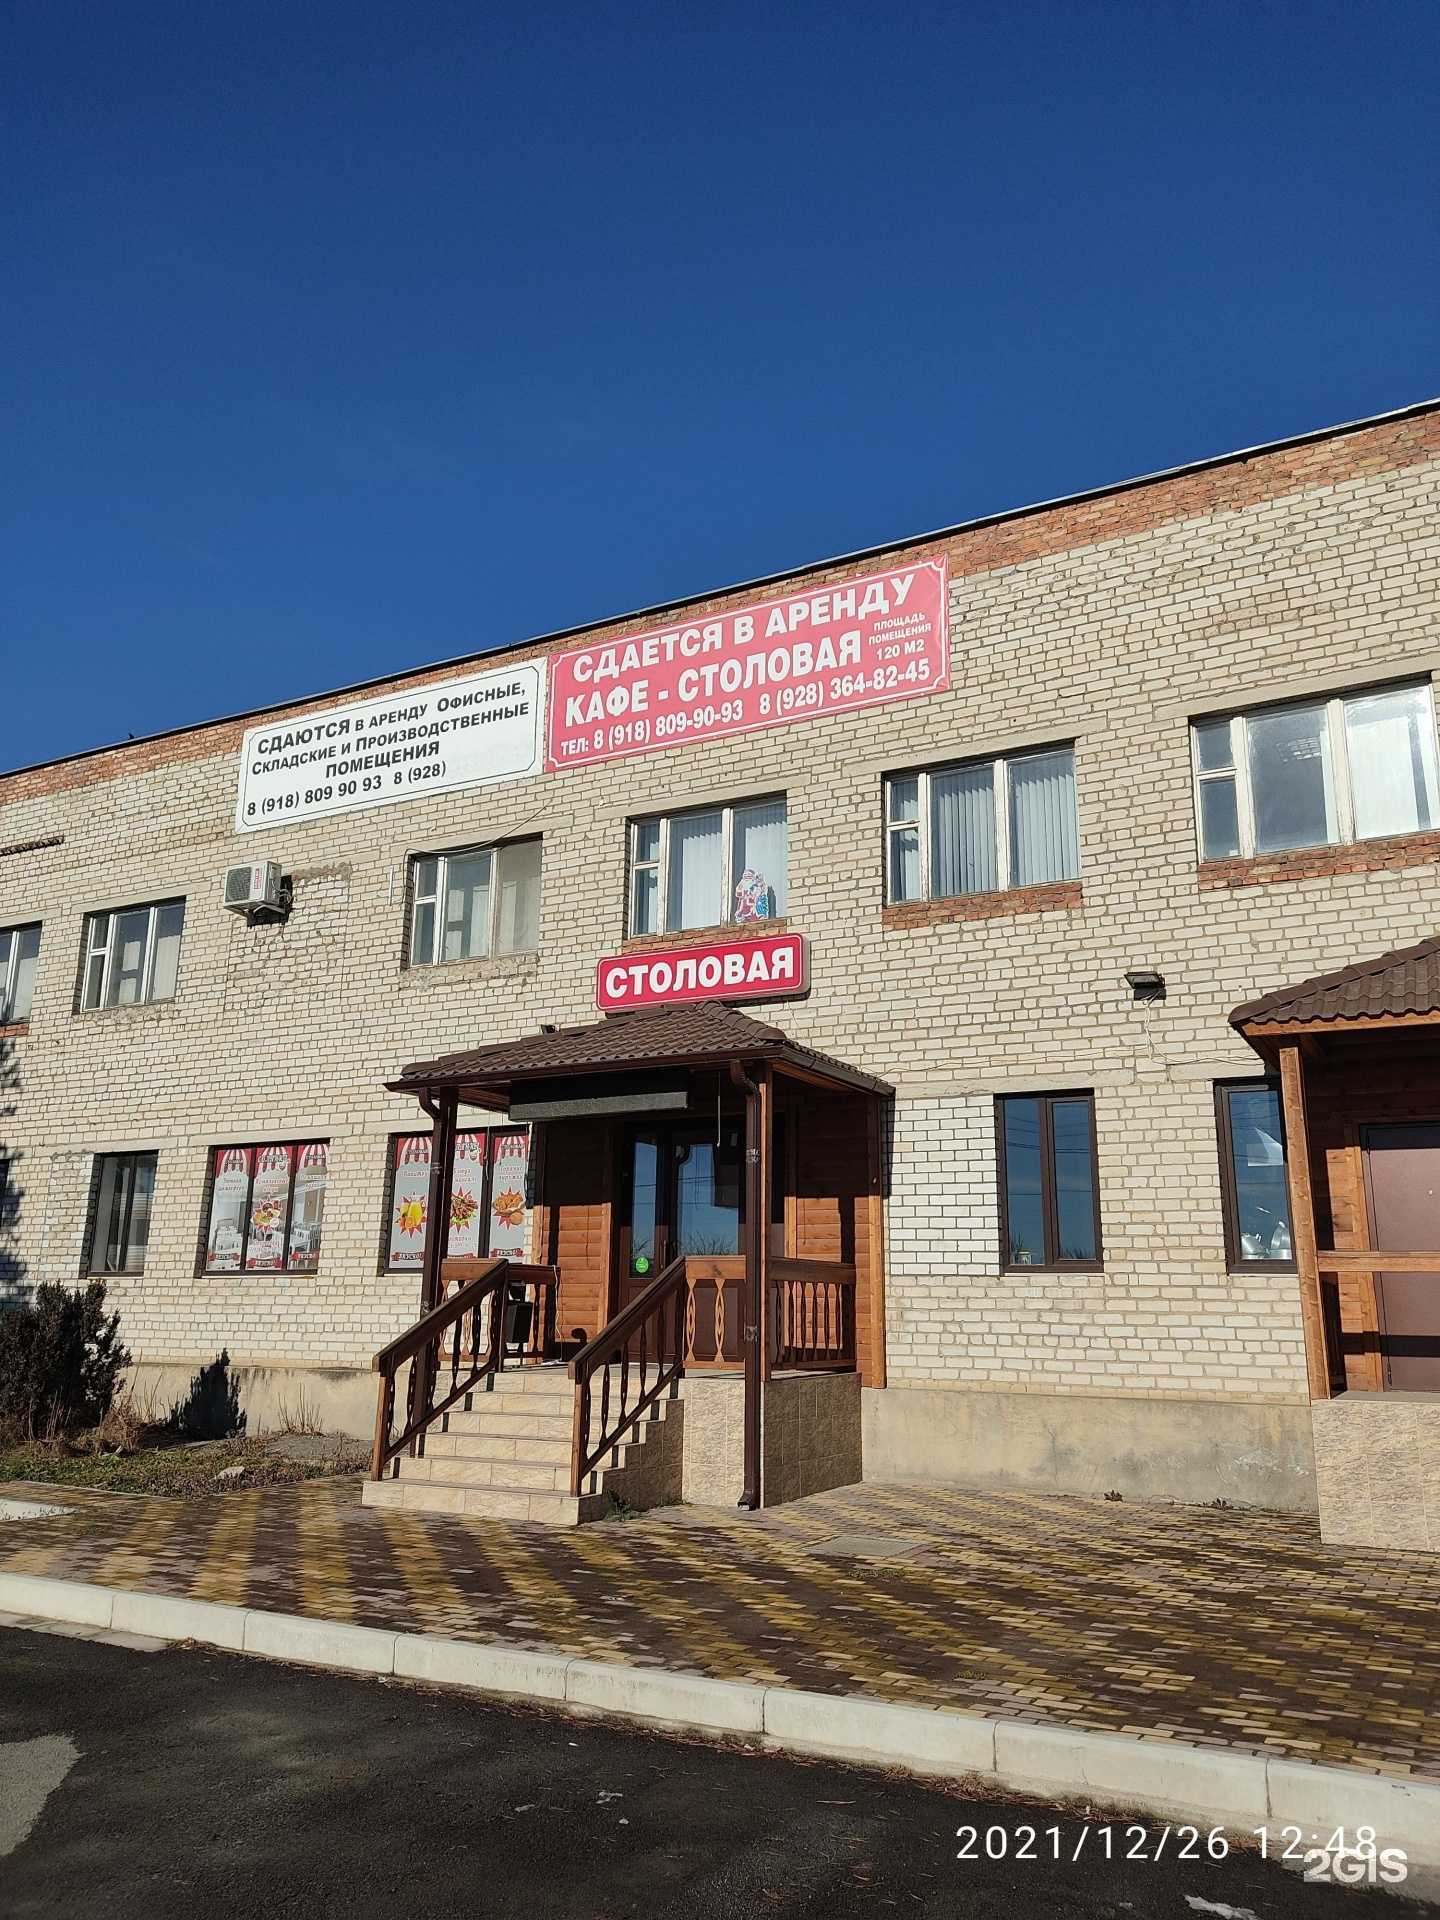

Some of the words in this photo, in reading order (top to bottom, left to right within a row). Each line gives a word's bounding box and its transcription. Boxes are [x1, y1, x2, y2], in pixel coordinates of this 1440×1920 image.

[573, 622, 723, 683] СДАЕТСЯ
[733, 614, 755, 645] В
[764, 574, 915, 638] АРЕНДУ
[868, 623, 932, 645] ПОМЕЩЕНИЯ
[873, 612, 925, 632] ПЛОЩАДЬ
[876, 643, 901, 661] 120
[904, 638, 925, 655] М2
[565, 679, 649, 728] КАФЕ
[677, 630, 861, 704] СТОЛОВАЯ
[257, 718, 351, 754] СДАЮТСЯ
[368, 703, 428, 729] АРЕНДУ
[437, 682, 526, 712] ОФИСНЫЕ,
[561, 736, 590, 757] ТЕЛ:
[593, 730, 604, 750] 8
[608, 720, 651, 752] (918)
[655, 699, 743, 735] 809-90-93
[759, 693, 771, 715] 8
[776, 684, 825, 717] (928)
[829, 658, 931, 699] 364-82-45
[252, 745, 337, 776] СКЛАДСКИЕ
[341, 742, 352, 755] И
[356, 702, 530, 752] ПРОИЗВОДСТВЕННЫЕ
[325, 741, 441, 779] ПОМЕЩЕНИЯ
[247, 802, 257, 816] 8
[261, 790, 300, 816] (918)
[304, 785, 333, 804] 809
[338, 780, 357, 797] 90
[362, 775, 382, 792] 93
[393, 771, 403, 785] 8
[408, 760, 447, 784] (928)
[605, 947, 794, 999] СТОЛОВАЯ
